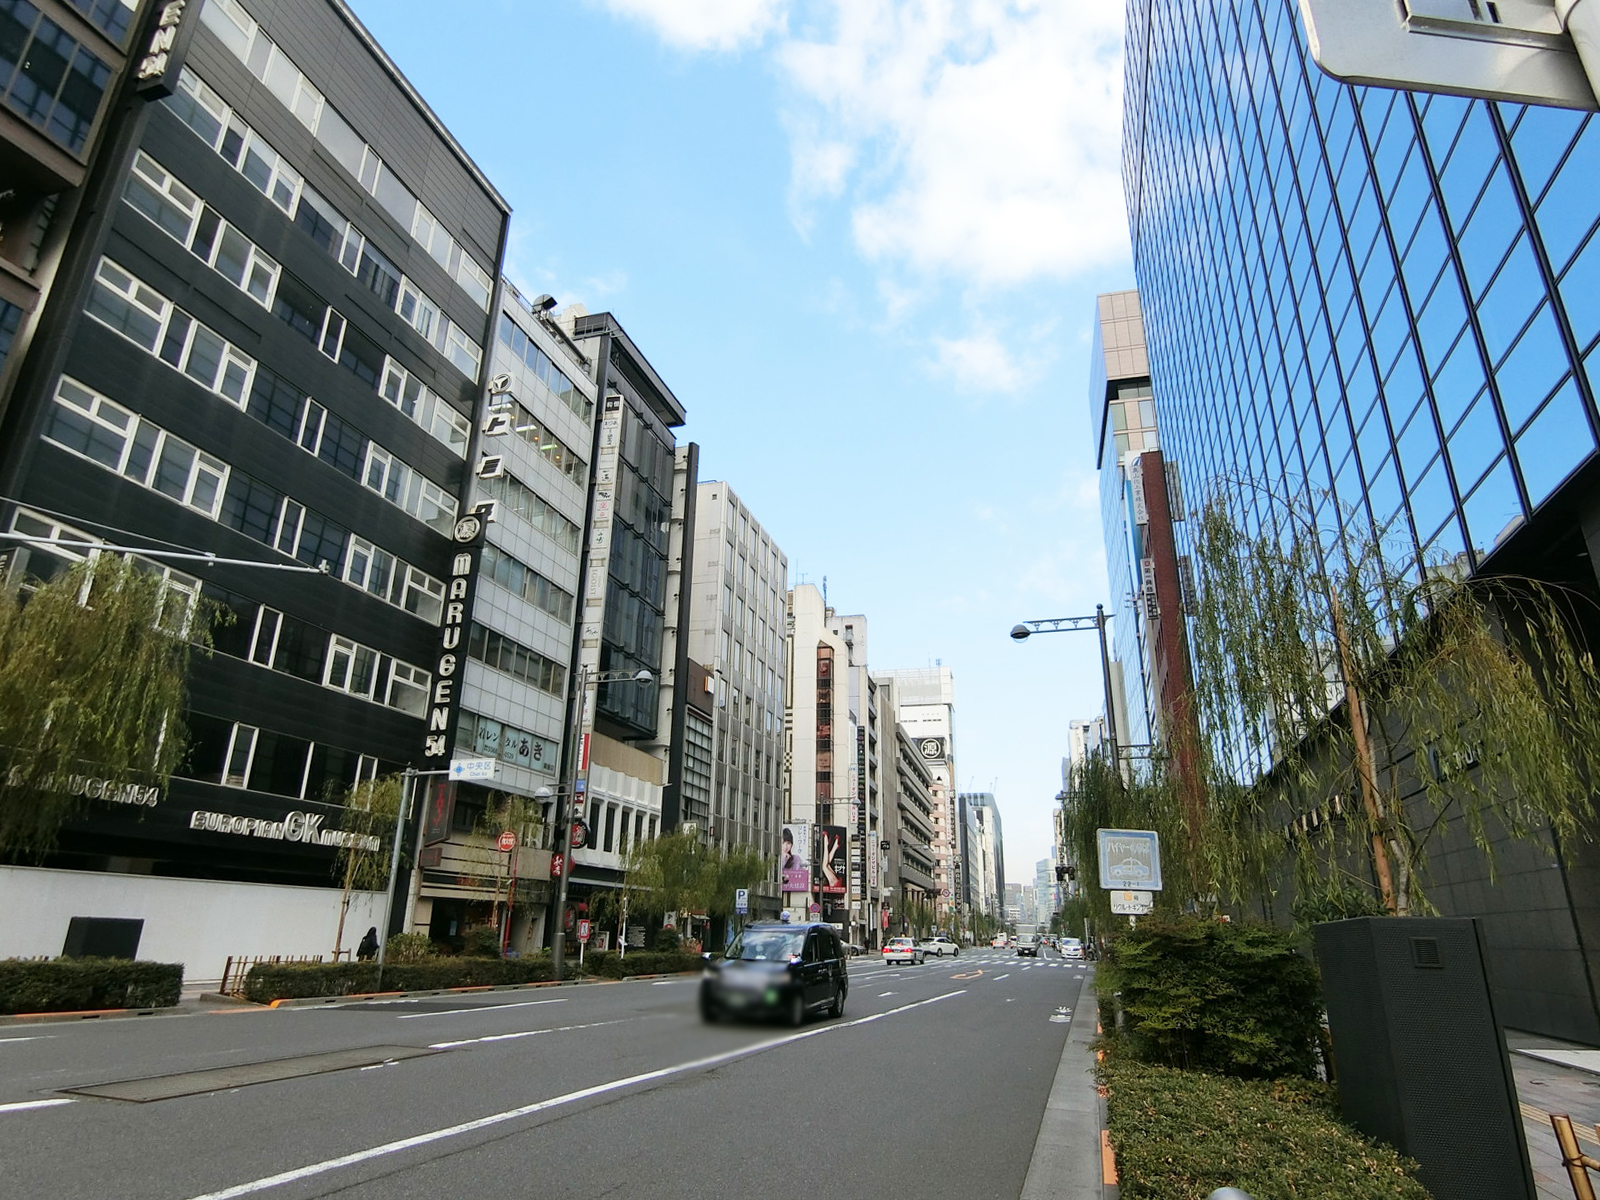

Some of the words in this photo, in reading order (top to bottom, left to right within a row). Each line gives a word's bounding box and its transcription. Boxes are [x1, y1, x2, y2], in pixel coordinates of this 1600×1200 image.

[430, 552, 472, 732] MARUGEN
[425, 734, 447, 758] 54
[466, 761, 492, 771] 中央区
[284, 811, 326, 844] GK
[737, 890, 746, 900] P
